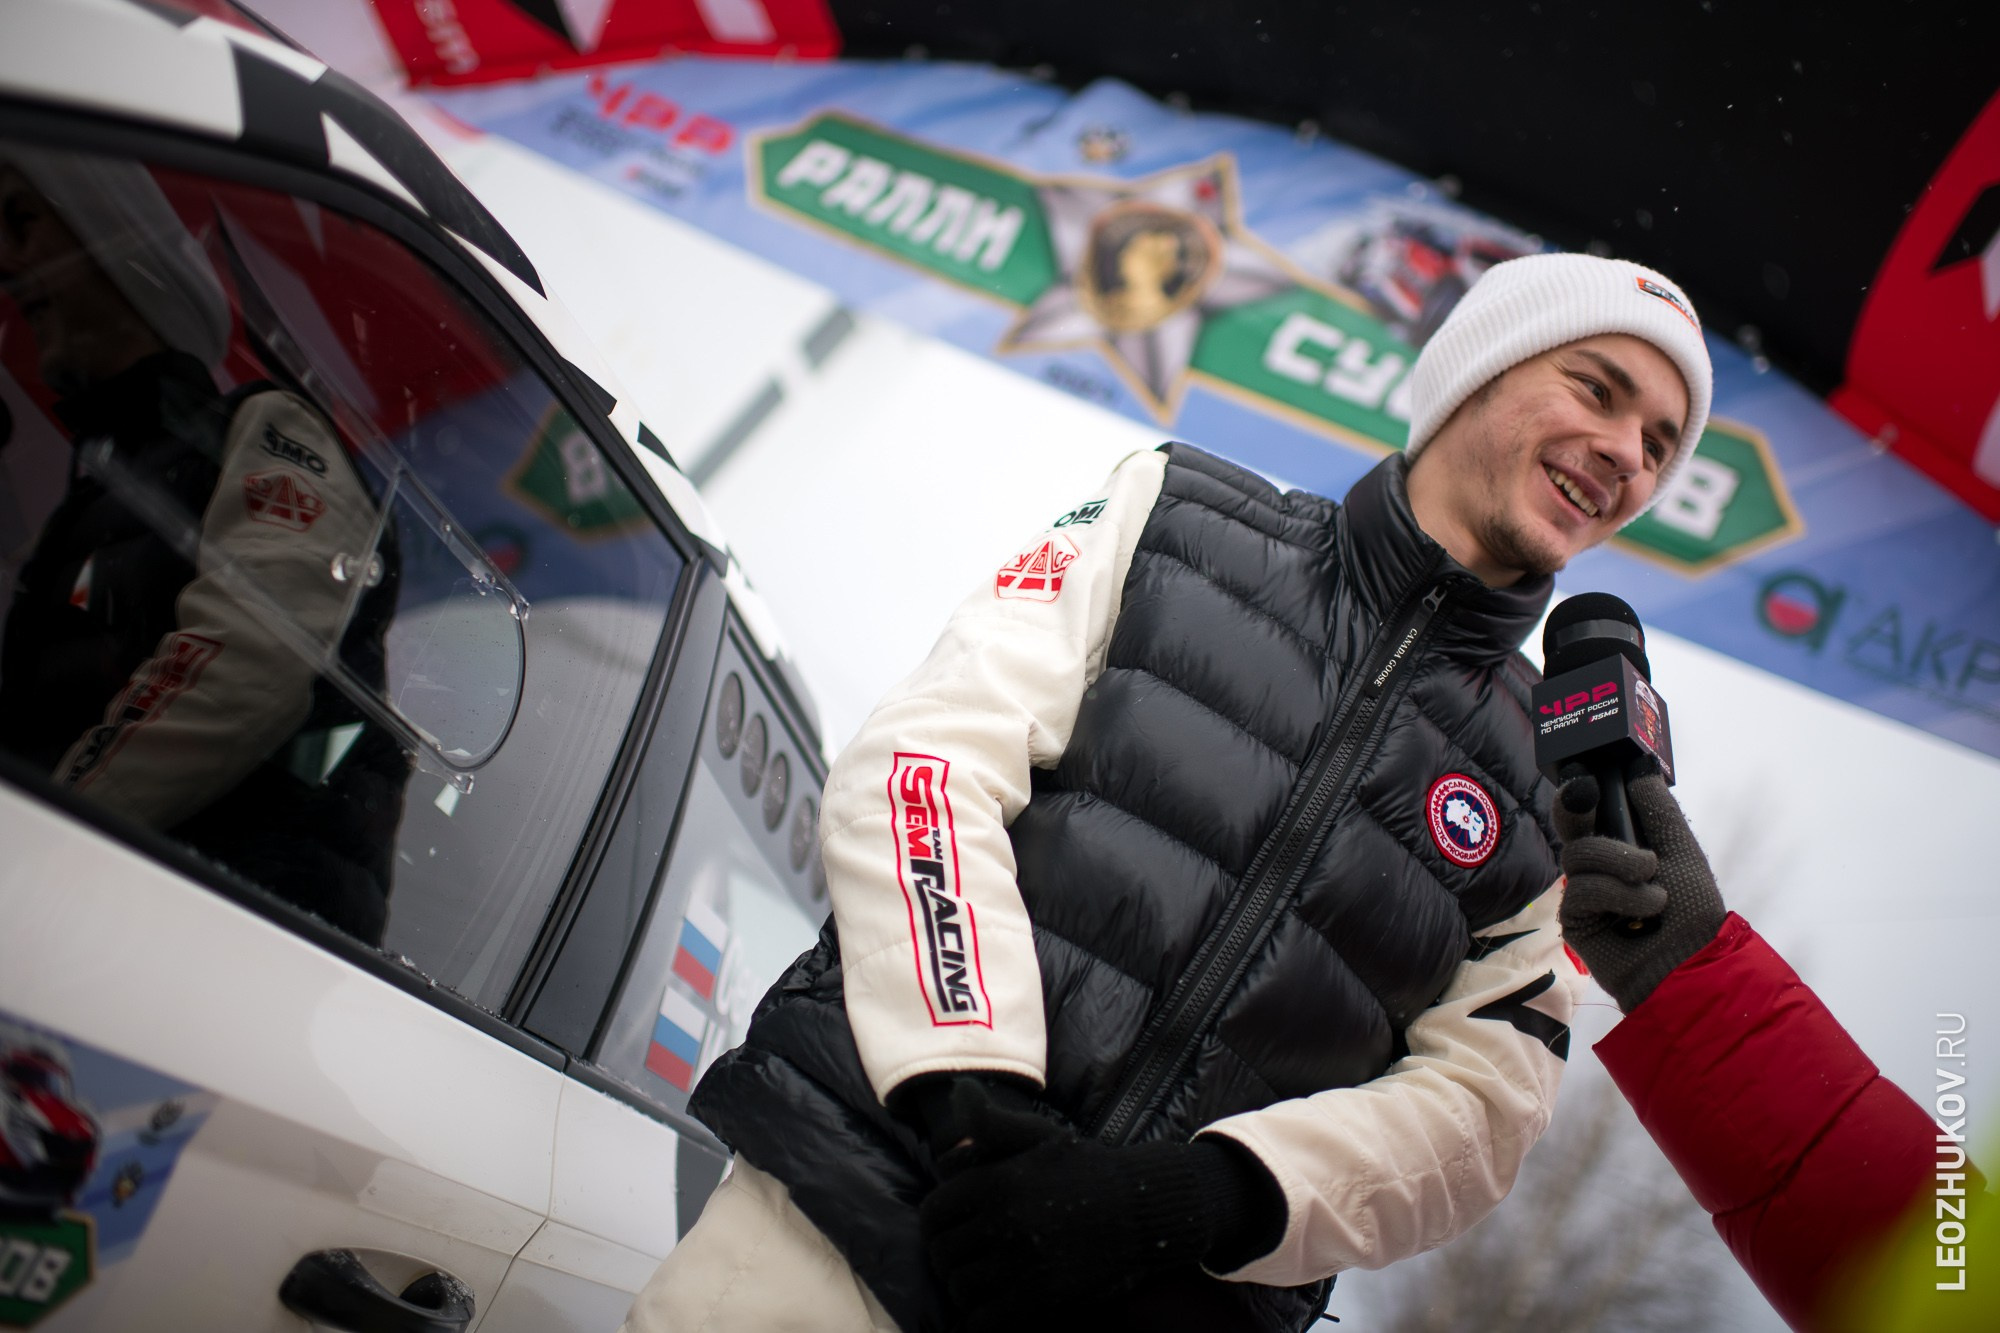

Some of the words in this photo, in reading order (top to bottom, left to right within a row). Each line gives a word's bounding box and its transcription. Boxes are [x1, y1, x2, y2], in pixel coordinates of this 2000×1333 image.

[776, 139, 1027, 272] РАЛЛИ
[1394, 628, 1418, 659] CANADA
[1374, 659, 1397, 687] GOOSE
[1540, 681, 1617, 716] ЧРР
[1540, 709, 1586, 728] ЧЕМПИОНАТ
[1587, 697, 1619, 712] РОССИИ
[1541, 727, 1552, 735] ПО
[1553, 717, 1579, 731] РАЛЛИ
[1448, 781, 1478, 796] CANADA
[1478, 793, 1494, 820] GOOSE
[1433, 814, 1448, 844] ARCTIC
[1446, 842, 1479, 860] PROGRAM
